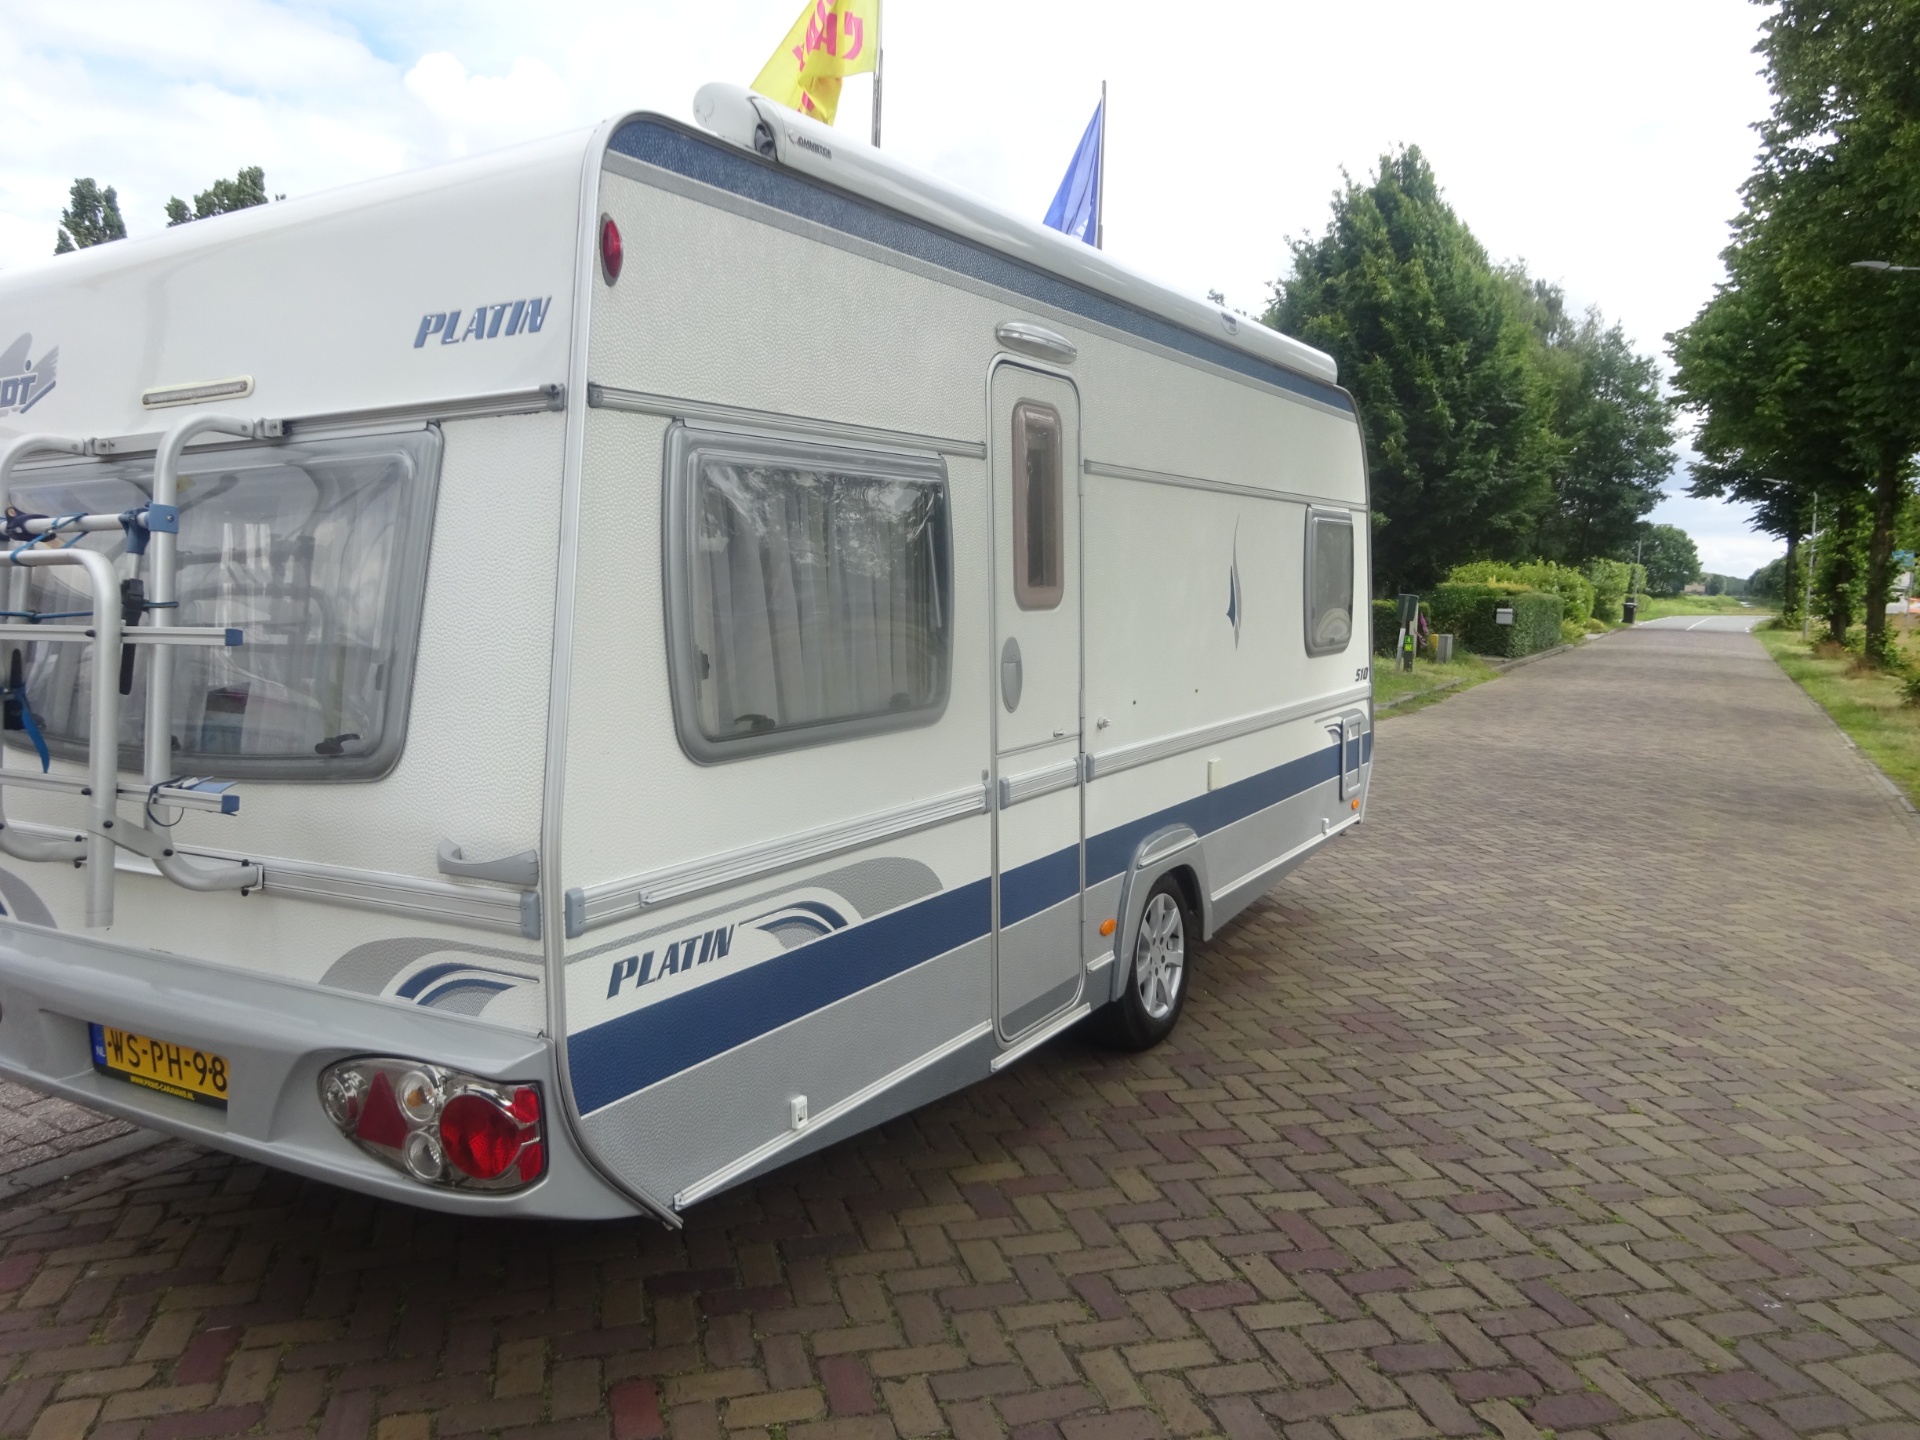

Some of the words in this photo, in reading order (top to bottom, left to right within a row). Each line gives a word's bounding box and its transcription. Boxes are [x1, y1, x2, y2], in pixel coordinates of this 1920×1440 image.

[413, 295, 552, 348] PLATIN
[1355, 667, 1368, 682] 510
[606, 923, 735, 1000] PLATIN
[108, 1029, 227, 1092] WS-PH-98
